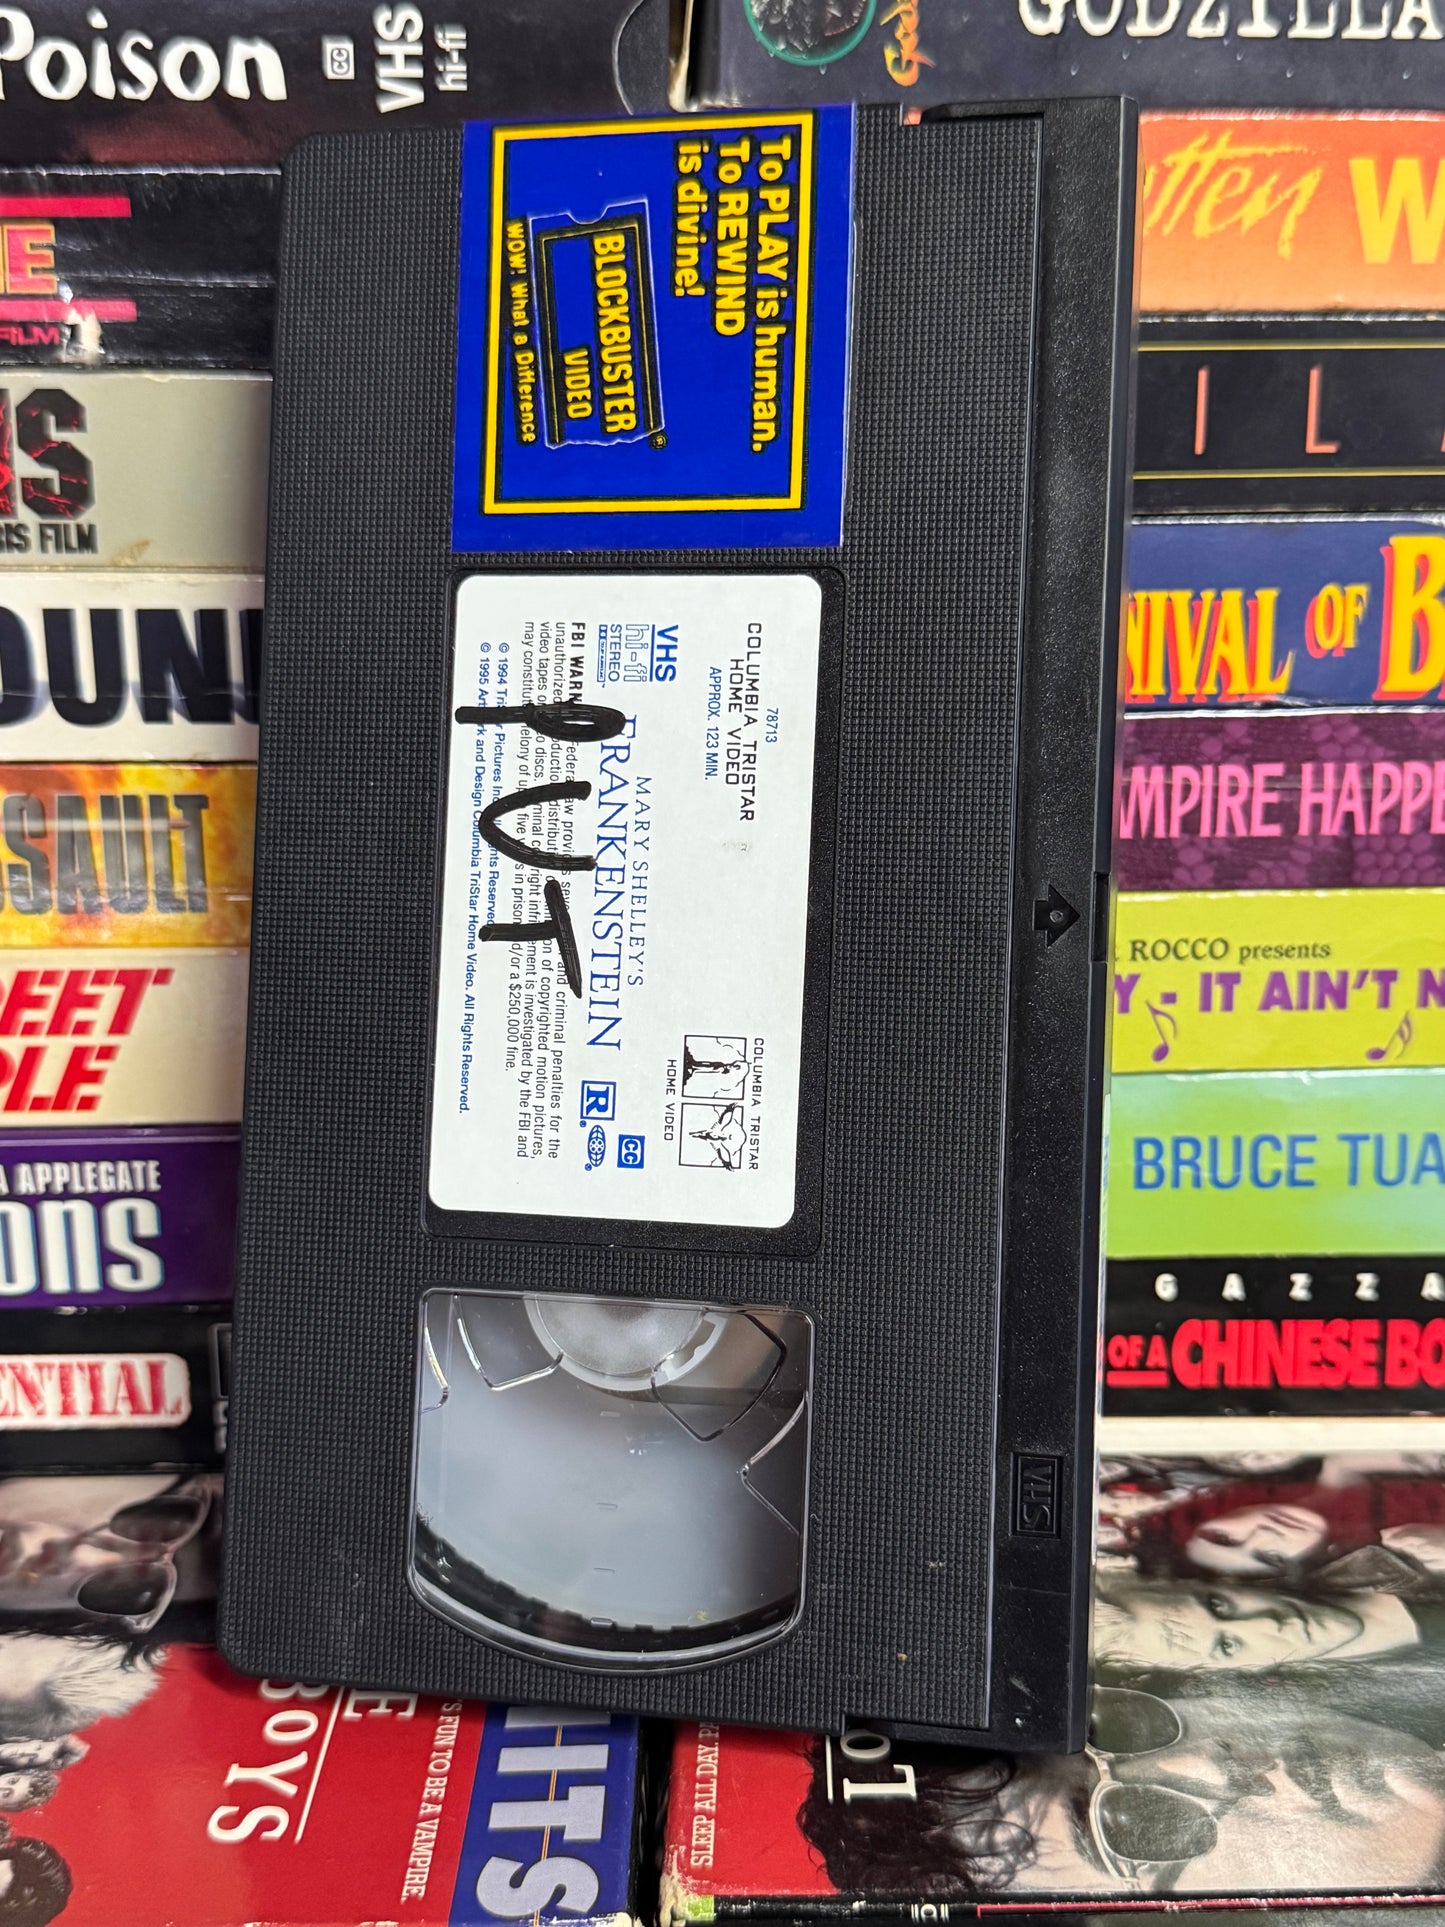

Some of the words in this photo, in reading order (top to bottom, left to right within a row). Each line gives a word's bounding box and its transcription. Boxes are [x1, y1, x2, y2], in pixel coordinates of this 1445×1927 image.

[1018, 0, 1445, 39] GODZILLA
[0, 6, 288, 101] Poison
[374, 3, 425, 113] VHS
[435, 24, 468, 91] hi-fi
[678, 142, 709, 174] is
[719, 137, 750, 184] To
[760, 136, 791, 180] To
[1144, 130, 1331, 261] tten
[506, 222, 528, 275] WOW!
[674, 179, 708, 297] divine!
[757, 185, 790, 281] PLAY
[0, 224, 58, 295] E
[715, 190, 749, 337] REWIND
[510, 281, 531, 328] What
[756, 288, 787, 320] is
[513, 331, 529, 346] a
[593, 232, 637, 434] BLOCKBUSTER
[514, 349, 537, 444] Difference
[563, 349, 593, 420] VIDEO
[752, 323, 787, 453] human.
[0, 388, 96, 521] S
[39, 523, 98, 554] FILM
[521, 621, 535, 648] may
[540, 621, 552, 653] video
[570, 621, 586, 648] FBI
[1305, 582, 1370, 658] OF
[478, 657, 490, 685] 1995
[497, 657, 509, 685] 1994
[536, 657, 549, 691] tapes
[608, 623, 623, 683] STEREO
[623, 623, 650, 683] hi-fi
[655, 624, 680, 683] VHS
[707, 666, 722, 722] APPROX.
[728, 658, 745, 713] HOME
[743, 622, 762, 728] COLUMBIA
[706, 726, 720, 750] 123
[765, 707, 780, 744] 78713
[475, 739, 487, 762] and
[491, 732, 506, 782] Pictures
[519, 764, 531, 777] of
[534, 747, 548, 782] discs.
[705, 752, 719, 781] MIN.
[725, 727, 742, 786] VIDEO
[471, 765, 486, 807] Design
[740, 740, 758, 822] TRISTAR
[516, 812, 530, 834] five
[633, 775, 653, 852] MARY
[0, 790, 209, 915] SAULT
[469, 810, 484, 868] Columbia
[469, 871, 481, 910] TriStar
[515, 873, 527, 884] in
[466, 914, 479, 950] Home
[627, 859, 651, 987] SHELLEY'S
[464, 952, 478, 991] Video.
[542, 959, 554, 972] of
[1129, 938, 1230, 963] ROCCO
[1238, 941, 1332, 965] presents
[511, 972, 521, 980] a
[524, 979, 538, 990] is
[1113, 973, 1141, 1014] Y
[1199, 972, 1242, 1013] IT
[1257, 969, 1400, 1012] AIN'T
[0, 967, 175, 1037] EET
[463, 993, 476, 1010] All
[505, 982, 521, 1043] $250,000
[536, 976, 552, 1051] copyrighted
[554, 991, 568, 1043] criminal
[460, 1012, 475, 1052] Rights
[519, 993, 536, 1067] investigated
[505, 1046, 519, 1072] fine.
[518, 1070, 533, 1085] by
[535, 1056, 549, 1099] motion
[550, 1049, 565, 1109] penalties
[665, 1059, 678, 1096] HOME
[751, 1037, 765, 1107] COLUMBIA
[459, 1053, 473, 1114] Reserved.
[519, 1089, 532, 1108] the
[584, 1083, 612, 1118] R
[518, 1111, 531, 1131] FBI
[531, 1104, 547, 1159] pictures,
[549, 1115, 563, 1134] for
[663, 1102, 675, 1141] VIDEO
[516, 1135, 529, 1158] and
[548, 1138, 562, 1159] the
[620, 1137, 642, 1167] CC
[748, 1115, 761, 1171] TRISTAR
[1132, 1134, 1318, 1190] BRUCE
[14, 1160, 162, 1196] APPLEGATE
[1107, 1334, 1144, 1369] OF
[1145, 1334, 1168, 1369] A
[1170, 1318, 1382, 1389] CHINESE
[433, 1715, 460, 1749] FUN
[428, 1749, 454, 1776] TO
[696, 1741, 720, 1778] DAY.
[422, 1776, 449, 1799] BE
[694, 1778, 718, 1813] ALL
[418, 1802, 443, 1819] A
[400, 1818, 440, 1905] VAMPIRE.
[690, 1815, 716, 1869] SLEEP
